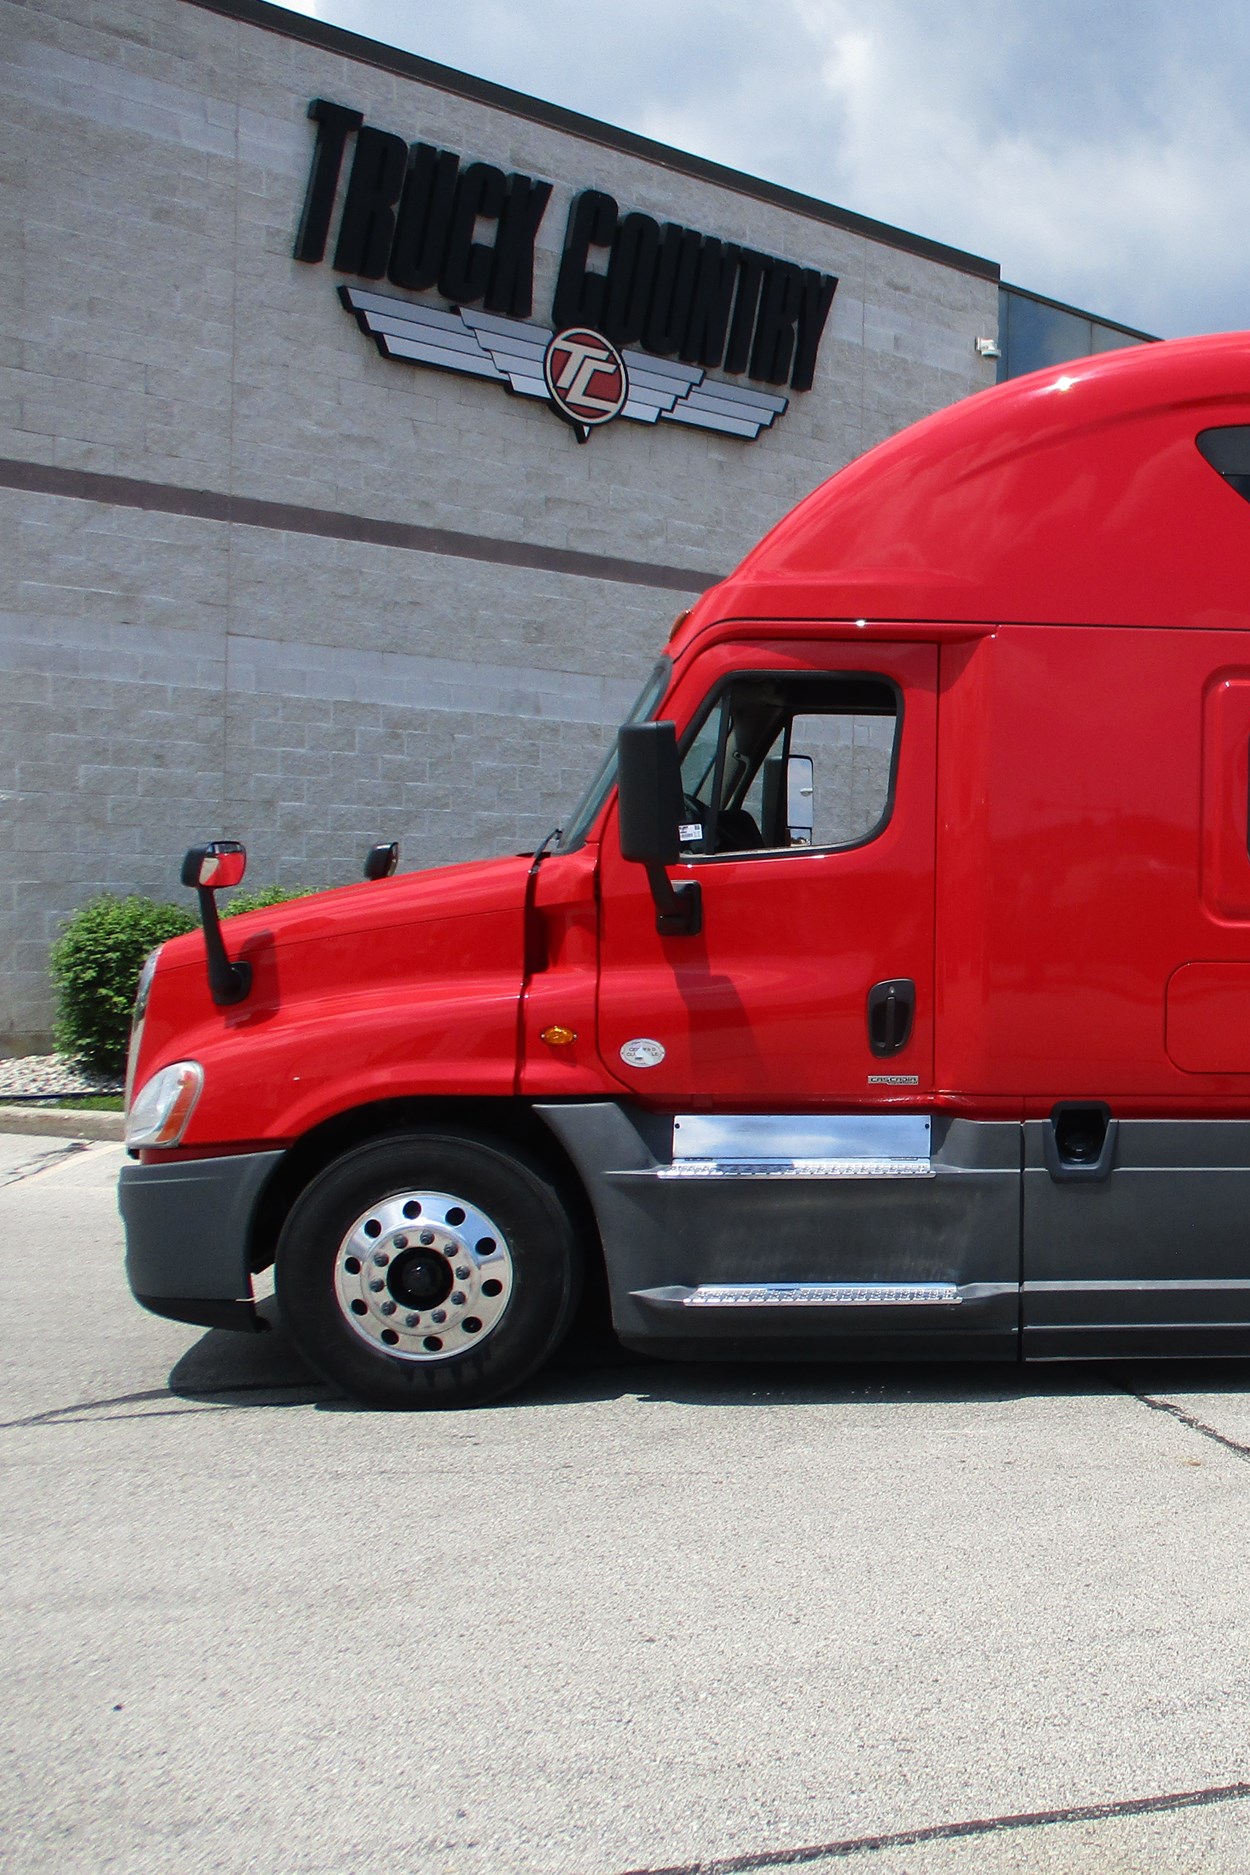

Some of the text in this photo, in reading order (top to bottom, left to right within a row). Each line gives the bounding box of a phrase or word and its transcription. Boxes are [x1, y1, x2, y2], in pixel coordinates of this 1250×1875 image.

[294, 98, 839, 392] TRUCK COUNTRY
[553, 339, 619, 412] TC
